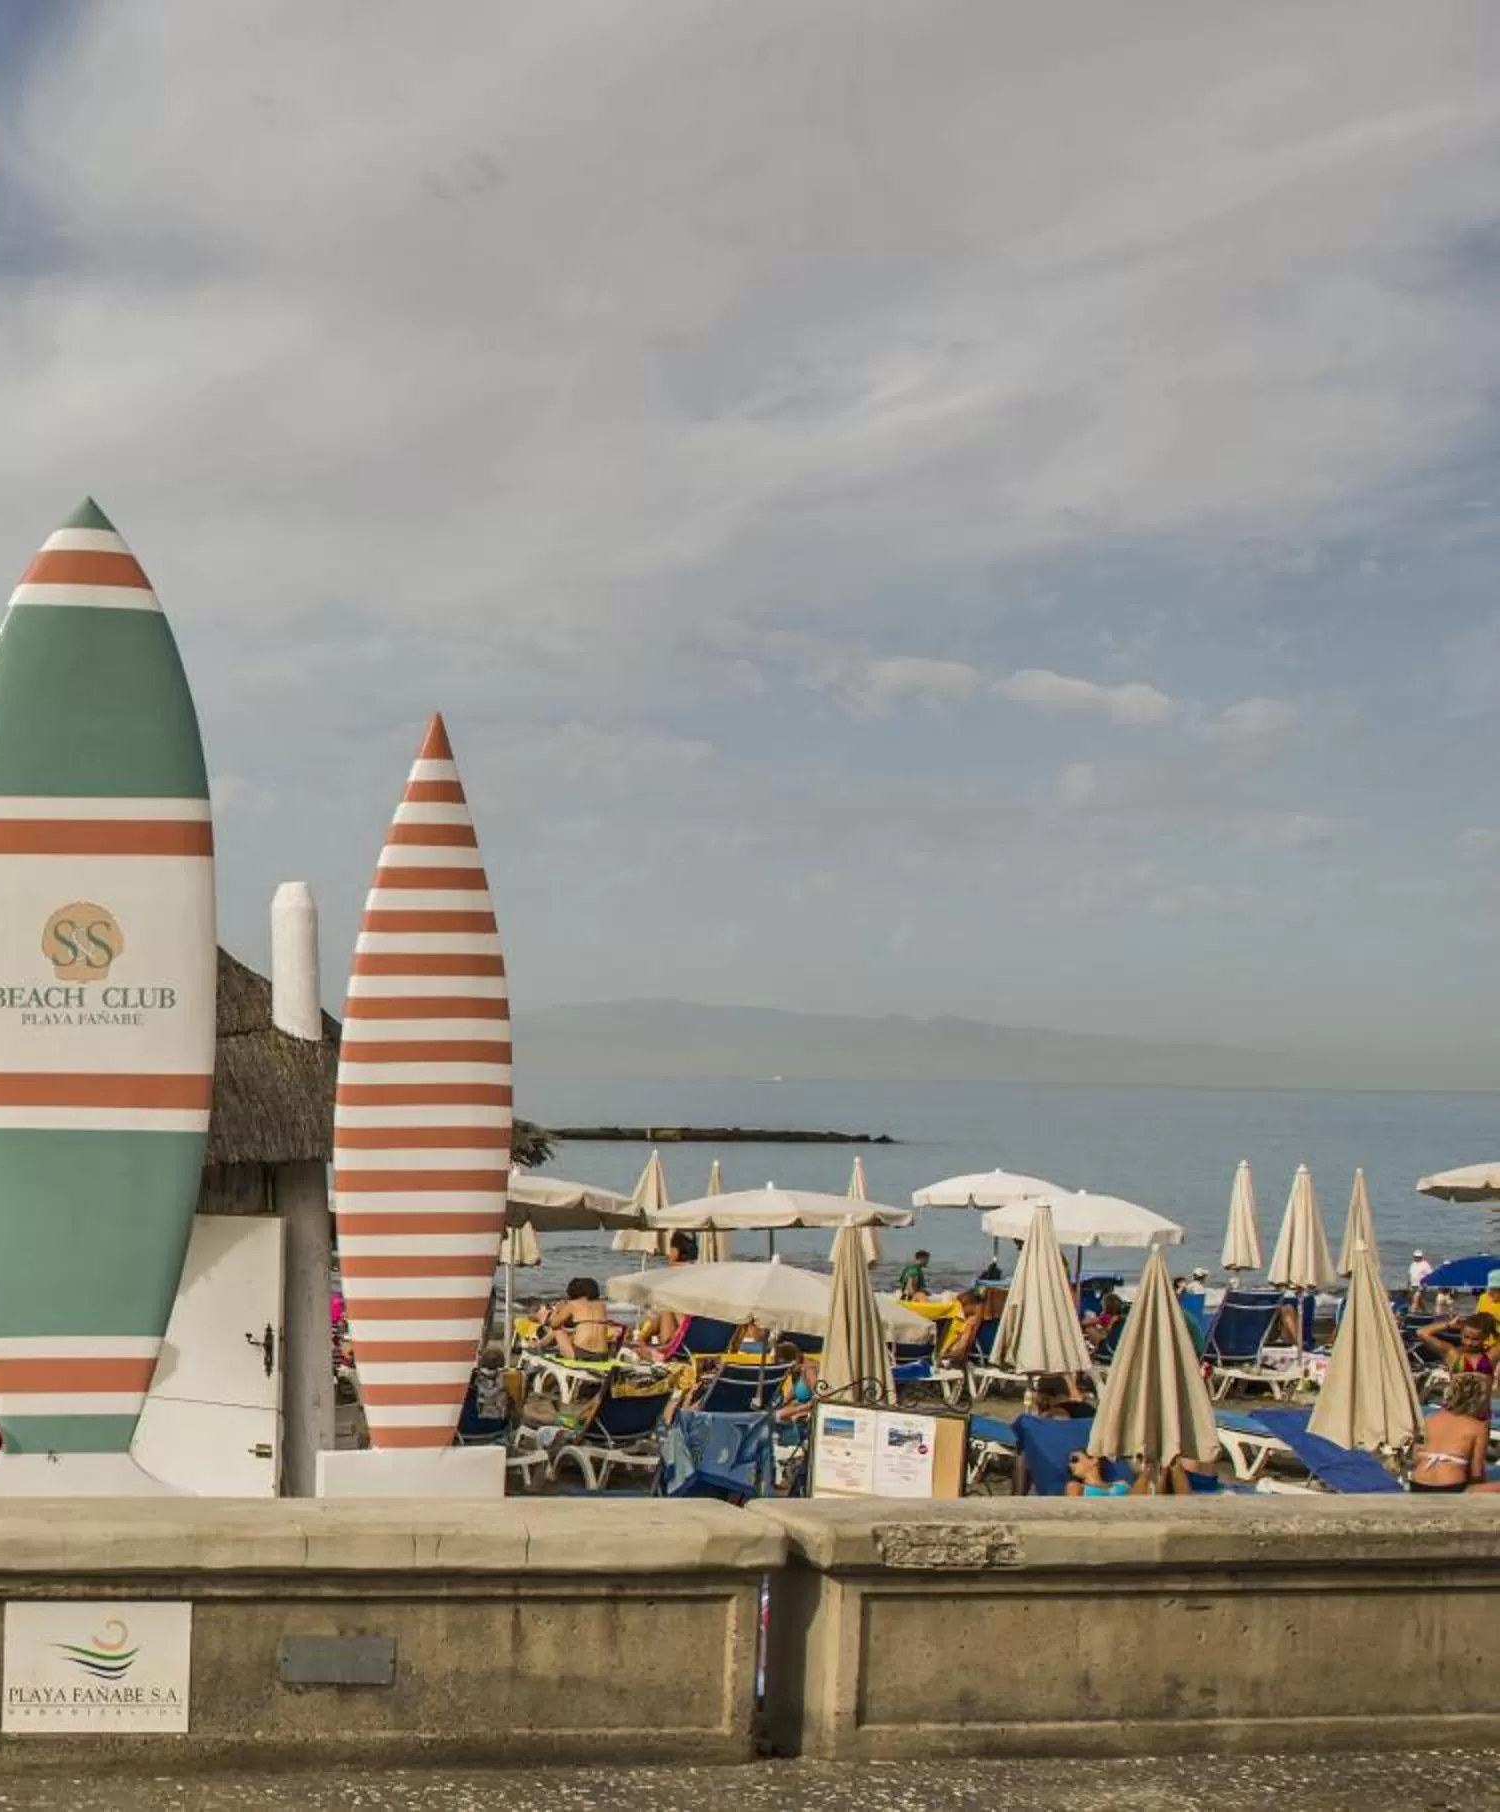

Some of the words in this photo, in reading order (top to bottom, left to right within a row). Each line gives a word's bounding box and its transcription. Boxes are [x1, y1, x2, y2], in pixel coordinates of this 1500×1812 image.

[102, 987, 177, 1009] CLUB
[21, 1012, 73, 1025] PLAYA
[9, 1687, 67, 1702] PLAYA
